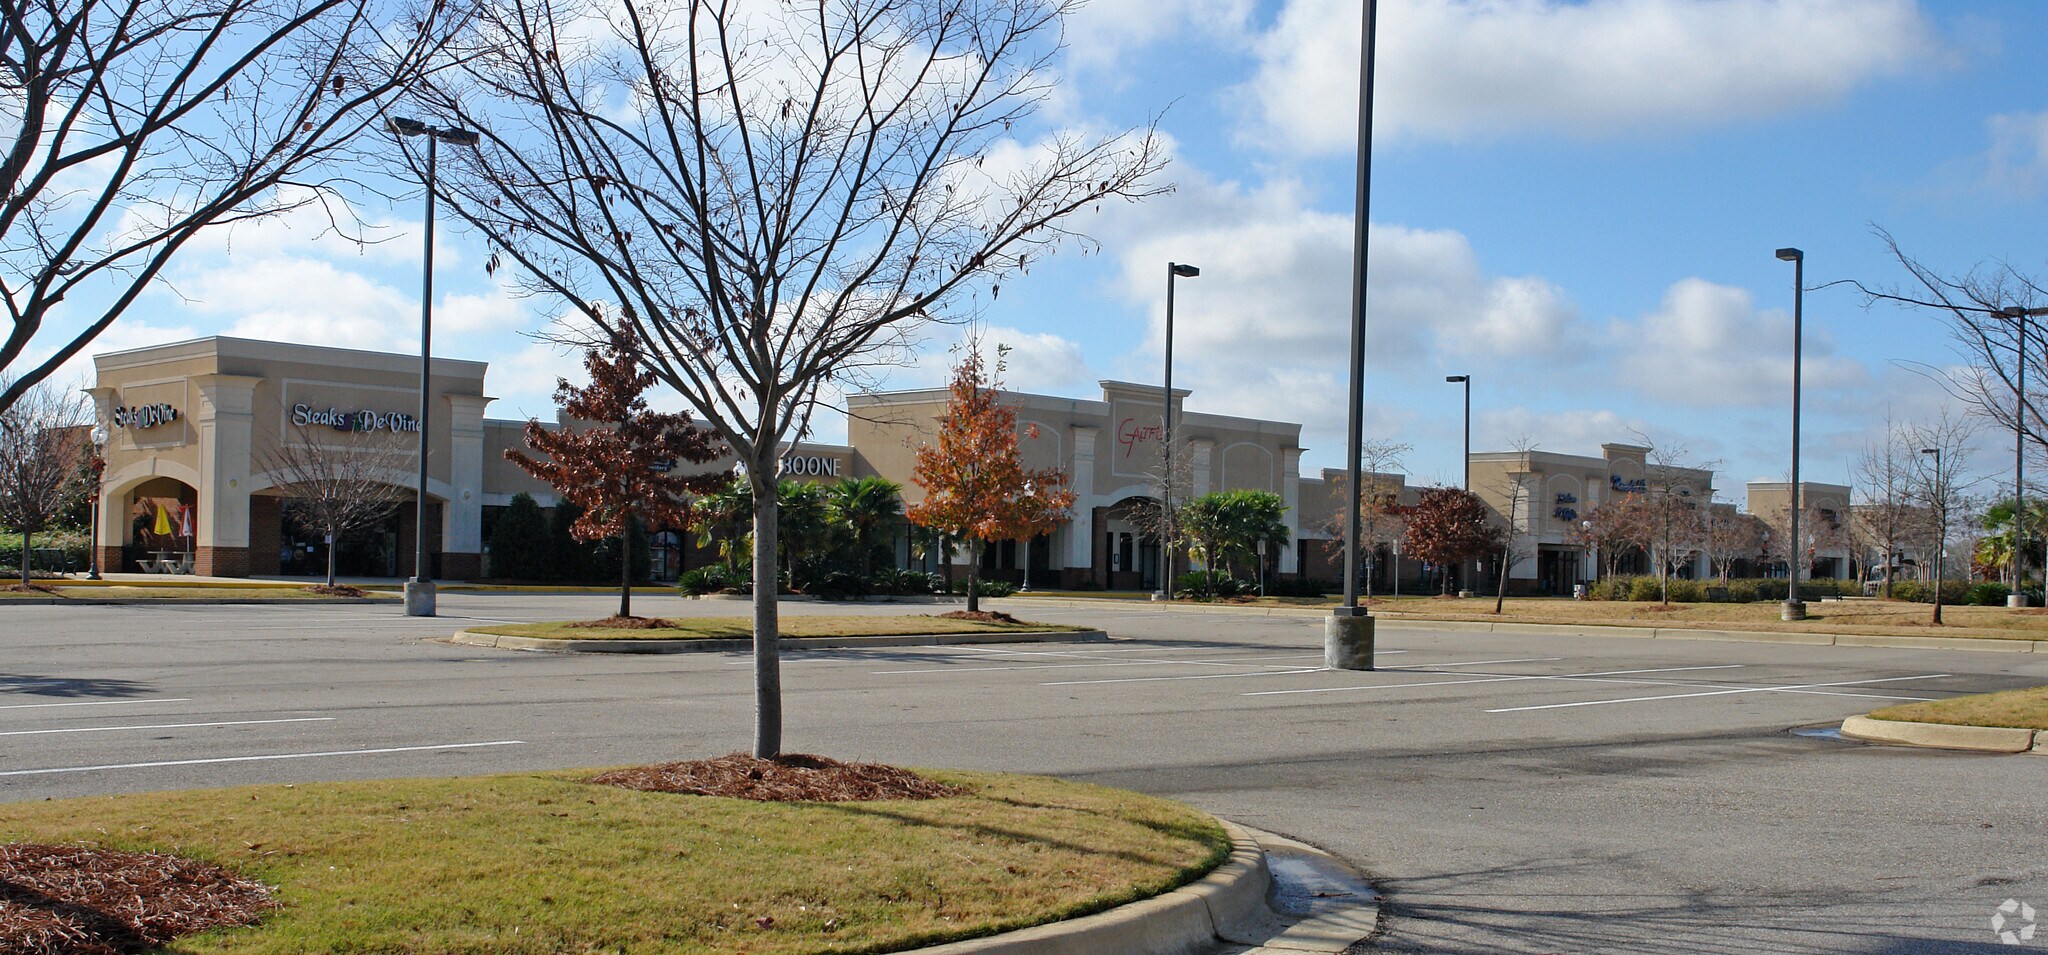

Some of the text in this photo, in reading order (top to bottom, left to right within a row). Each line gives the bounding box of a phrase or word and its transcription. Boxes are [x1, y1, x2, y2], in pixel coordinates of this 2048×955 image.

[114, 405, 137, 428] Steaks
[292, 402, 423, 434] Steaks DeVine
